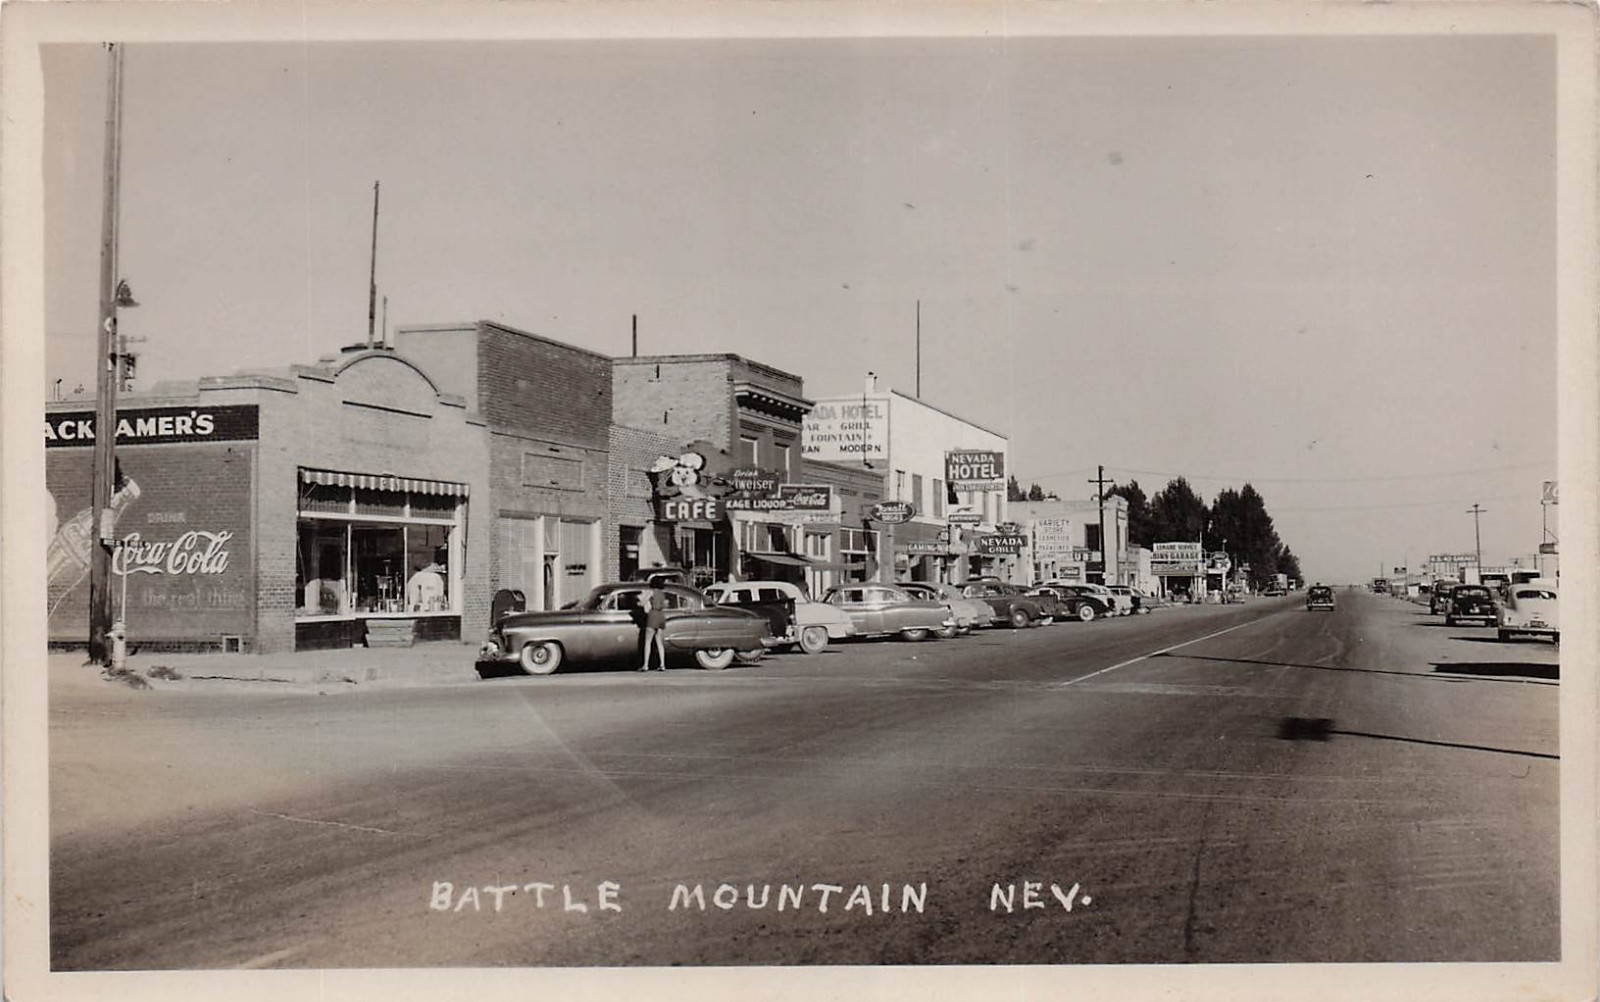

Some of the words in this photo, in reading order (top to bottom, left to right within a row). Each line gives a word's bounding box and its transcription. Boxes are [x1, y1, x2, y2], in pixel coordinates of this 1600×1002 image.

[841, 404, 883, 420] HOTEL
[840, 422, 872, 431] GRILL
[840, 444, 881, 453] MODERN
[952, 454, 995, 463] NEVADA
[949, 463, 1000, 479] HOTEL
[726, 499, 751, 509] KAGE
[753, 500, 786, 509] LIQUOR
[665, 501, 717, 519] CAFE
[981, 538, 1023, 546] NEVADA
[112, 530, 234, 576] Coca-Cola
